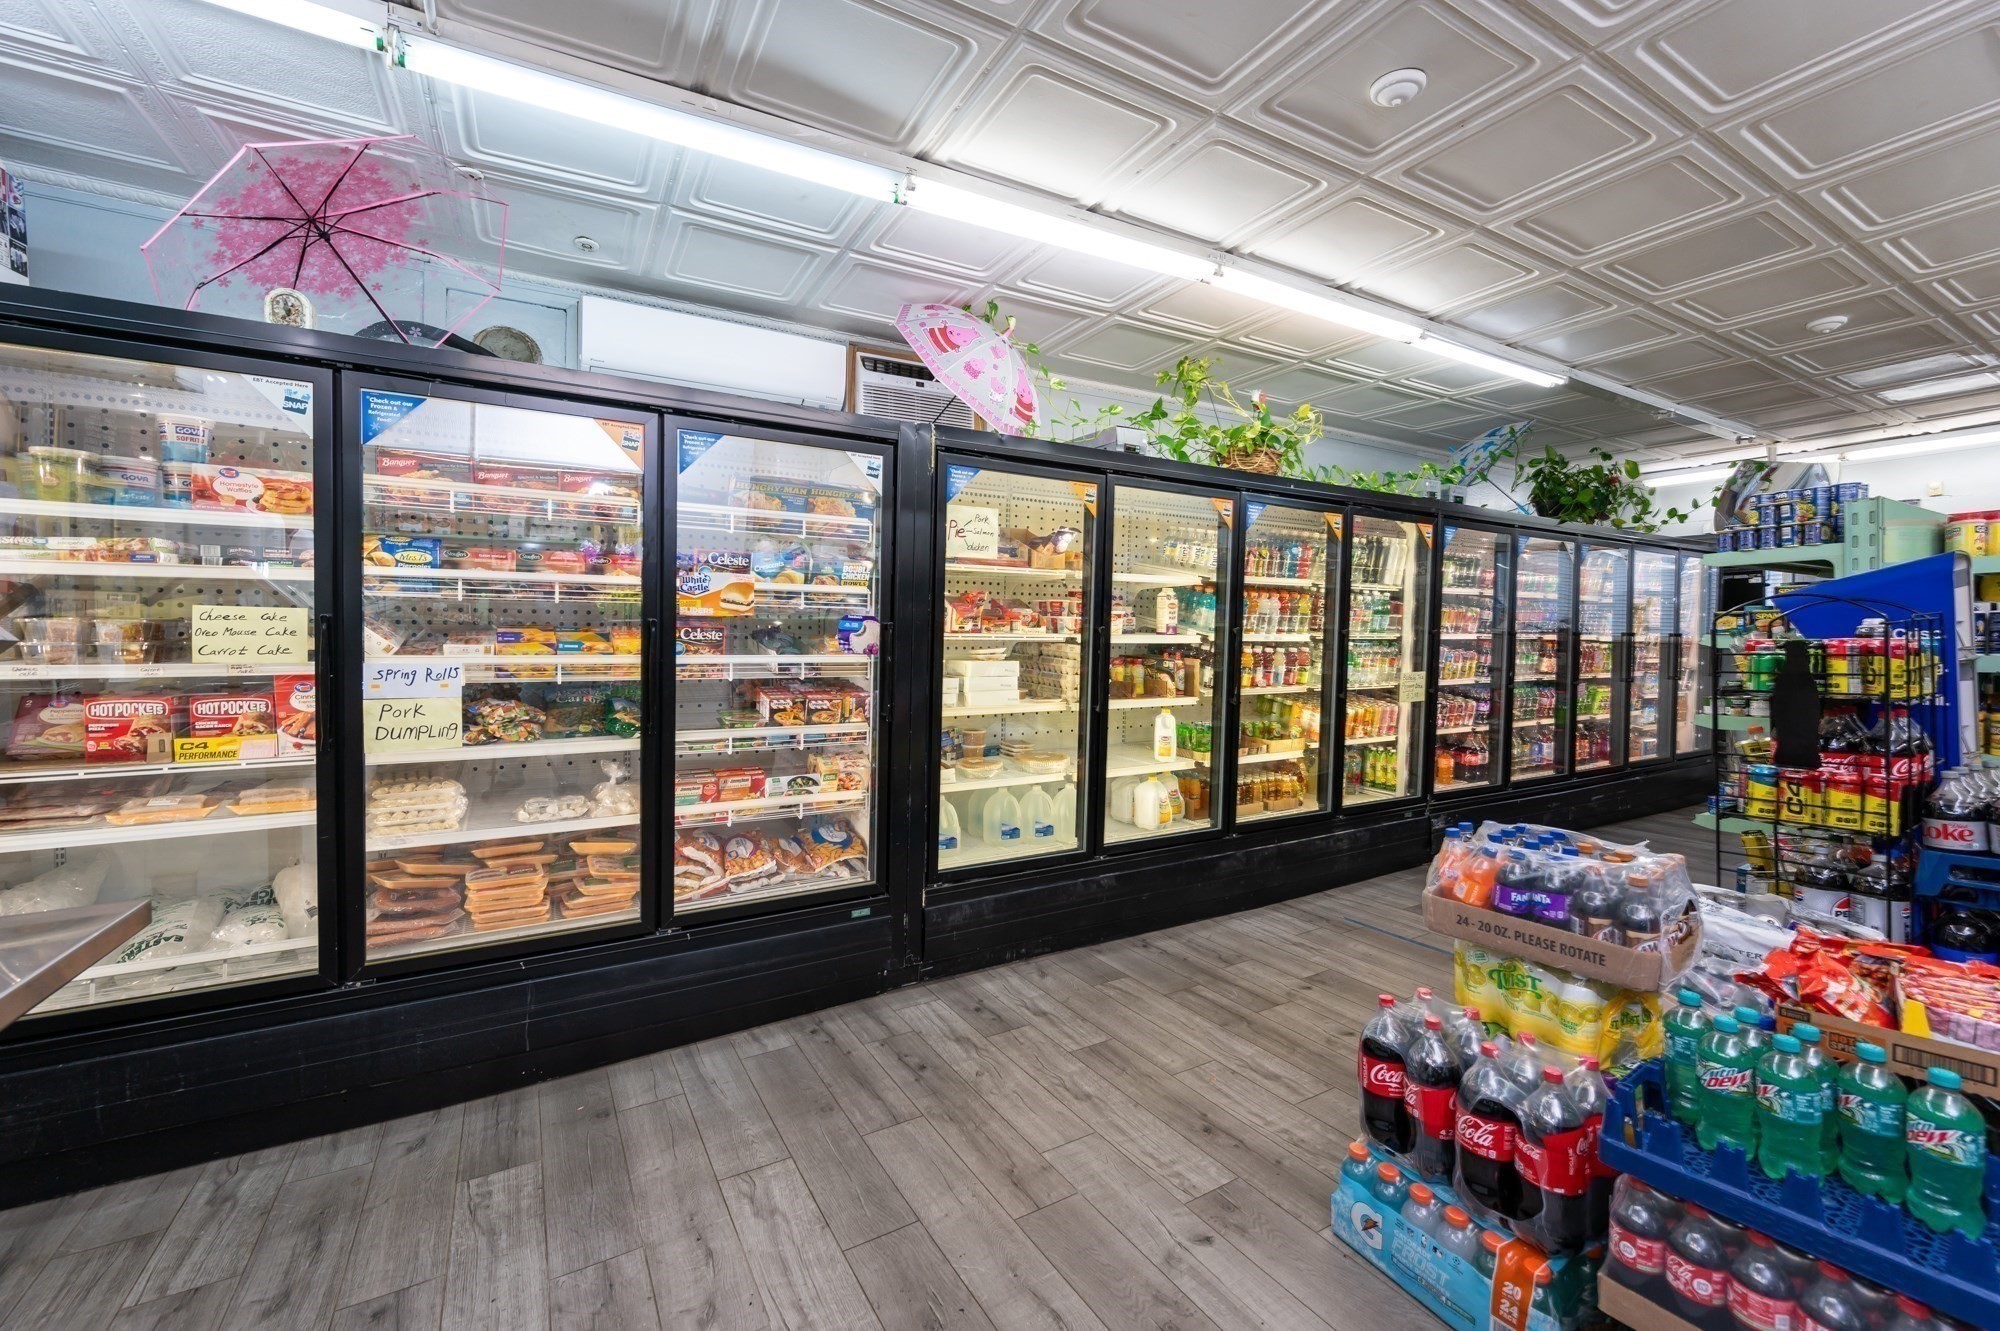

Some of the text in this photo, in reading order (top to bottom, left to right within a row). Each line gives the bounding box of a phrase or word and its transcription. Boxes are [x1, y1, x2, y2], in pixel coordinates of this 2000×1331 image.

[283, 401, 308, 410] SNAP
[370, 396, 389, 404] Check
[382, 457, 417, 466] Banquet
[478, 470, 509, 480] Banquet
[564, 474, 593, 482] Banquet
[948, 520, 966, 540] Pie
[708, 552, 750, 566] Celeste
[682, 576, 708, 584] White
[842, 572, 870, 581] CHICKEN
[680, 584, 709, 592] Castle
[200, 608, 248, 620] Cheese
[194, 626, 298, 637] Oreo Mousse Cake
[680, 627, 722, 640] Celeste
[198, 644, 292, 656] Carrot Cake
[426, 667, 460, 683] Rolls
[90, 702, 164, 718] HOT POCKETS
[198, 700, 267, 715] HOT POCKETS
[379, 702, 426, 722] Pork
[180, 742, 209, 750] C4
[179, 750, 238, 760] PERFORMANCE
[1786, 780, 1803, 815] C4
[1926, 824, 1974, 842] oke
[1456, 914, 1469, 927] 24
[1478, 920, 1491, 933] 20
[1494, 924, 1511, 939] OZ.
[1514, 930, 1556, 952] PLEASE
[1560, 943, 1606, 967] ROTATE
[1370, 1064, 1404, 1088] Coca
[1458, 1115, 1499, 1147] Cola
[1502, 1281, 1522, 1300] 20
[1500, 1299, 1518, 1318] 24
